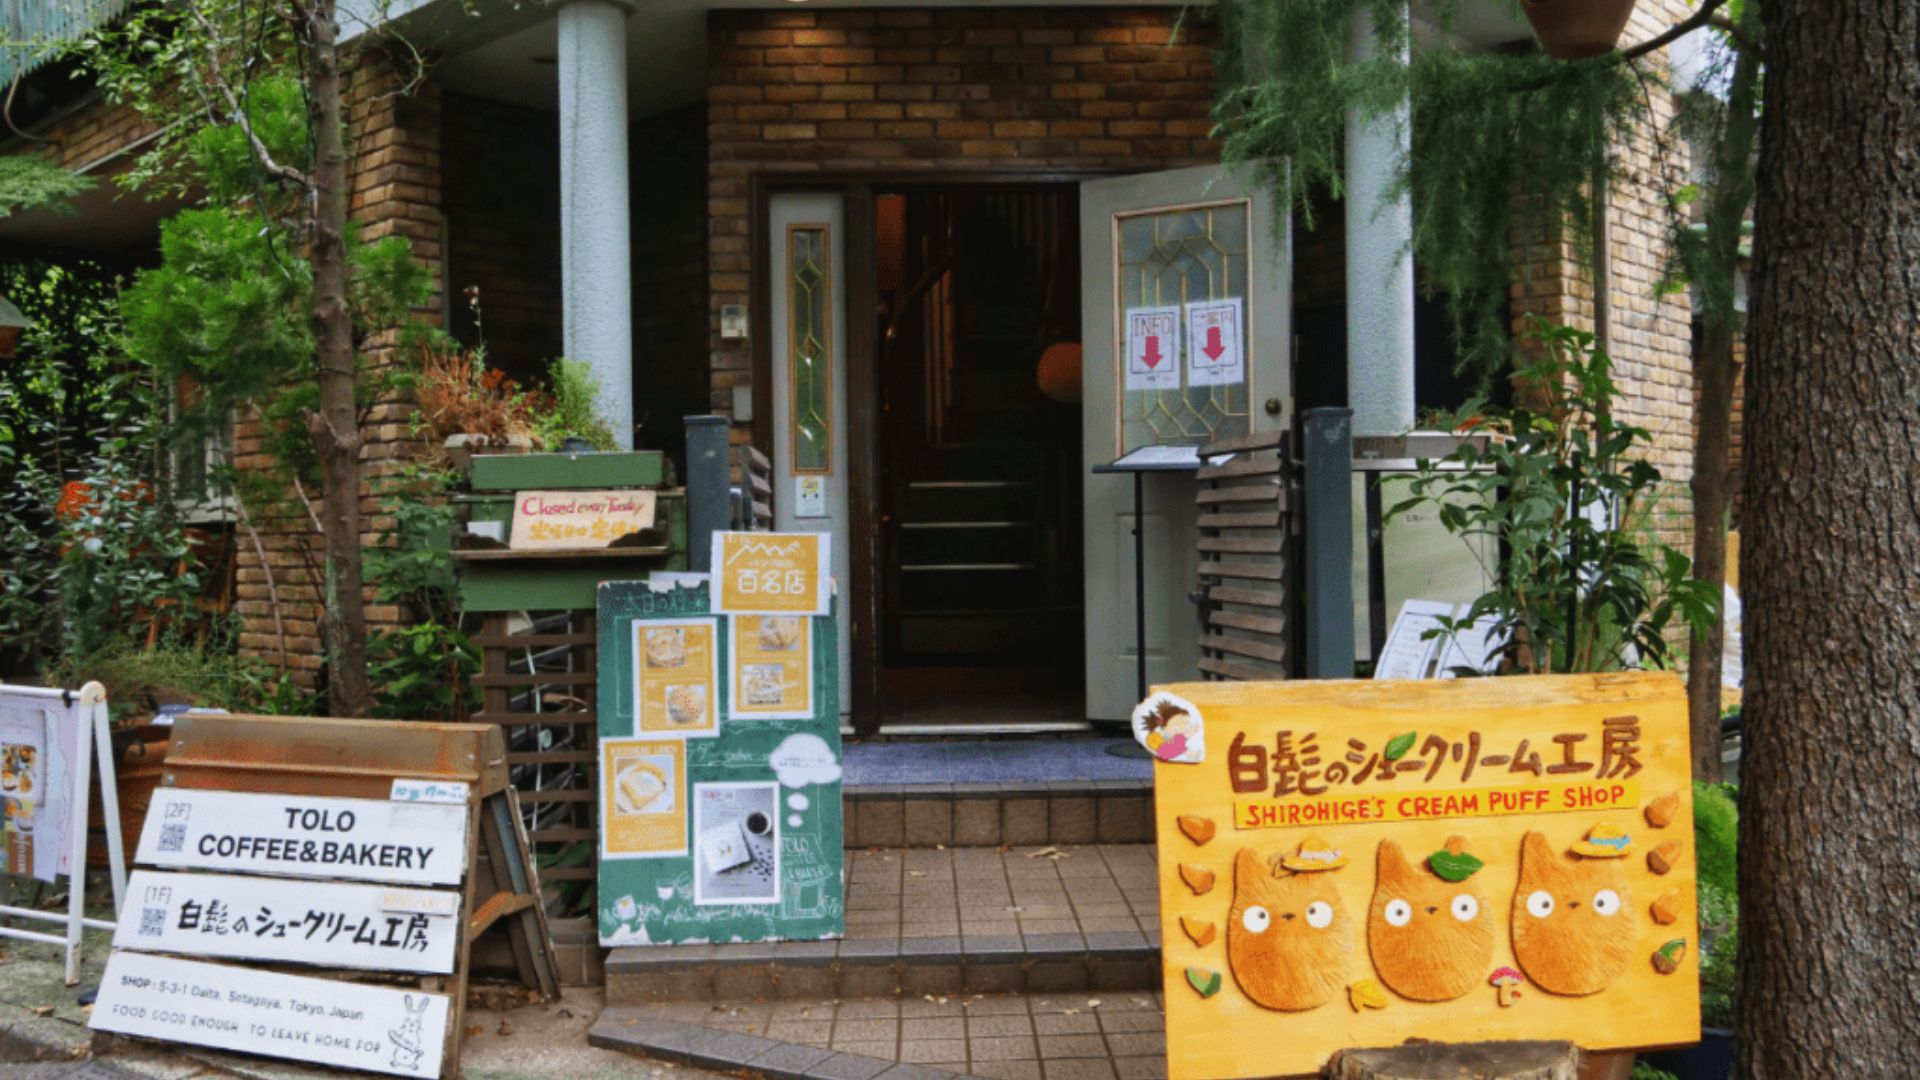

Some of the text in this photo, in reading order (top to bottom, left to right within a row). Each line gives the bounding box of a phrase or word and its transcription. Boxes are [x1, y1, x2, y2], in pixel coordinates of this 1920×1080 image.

[521, 496, 576, 516] Closed
[737, 569, 806, 595] 百名店
[1228, 715, 1644, 798] 白髭のシュークリーム工房
[285, 807, 355, 833] TOLO
[1246, 784, 1625, 826] SHIROHIGE'S CREAM PUFF SHOP
[198, 834, 434, 870] COFFEE&BAKERY
[178, 898, 429, 953] 白髭のシュークリーム工房
[159, 982, 187, 996] 5-3-1
[329, 1006, 365, 1021] Japan
[113, 1004, 381, 1053] FOOD GOOD ENOUGH TO LEAVE HOME FOR
